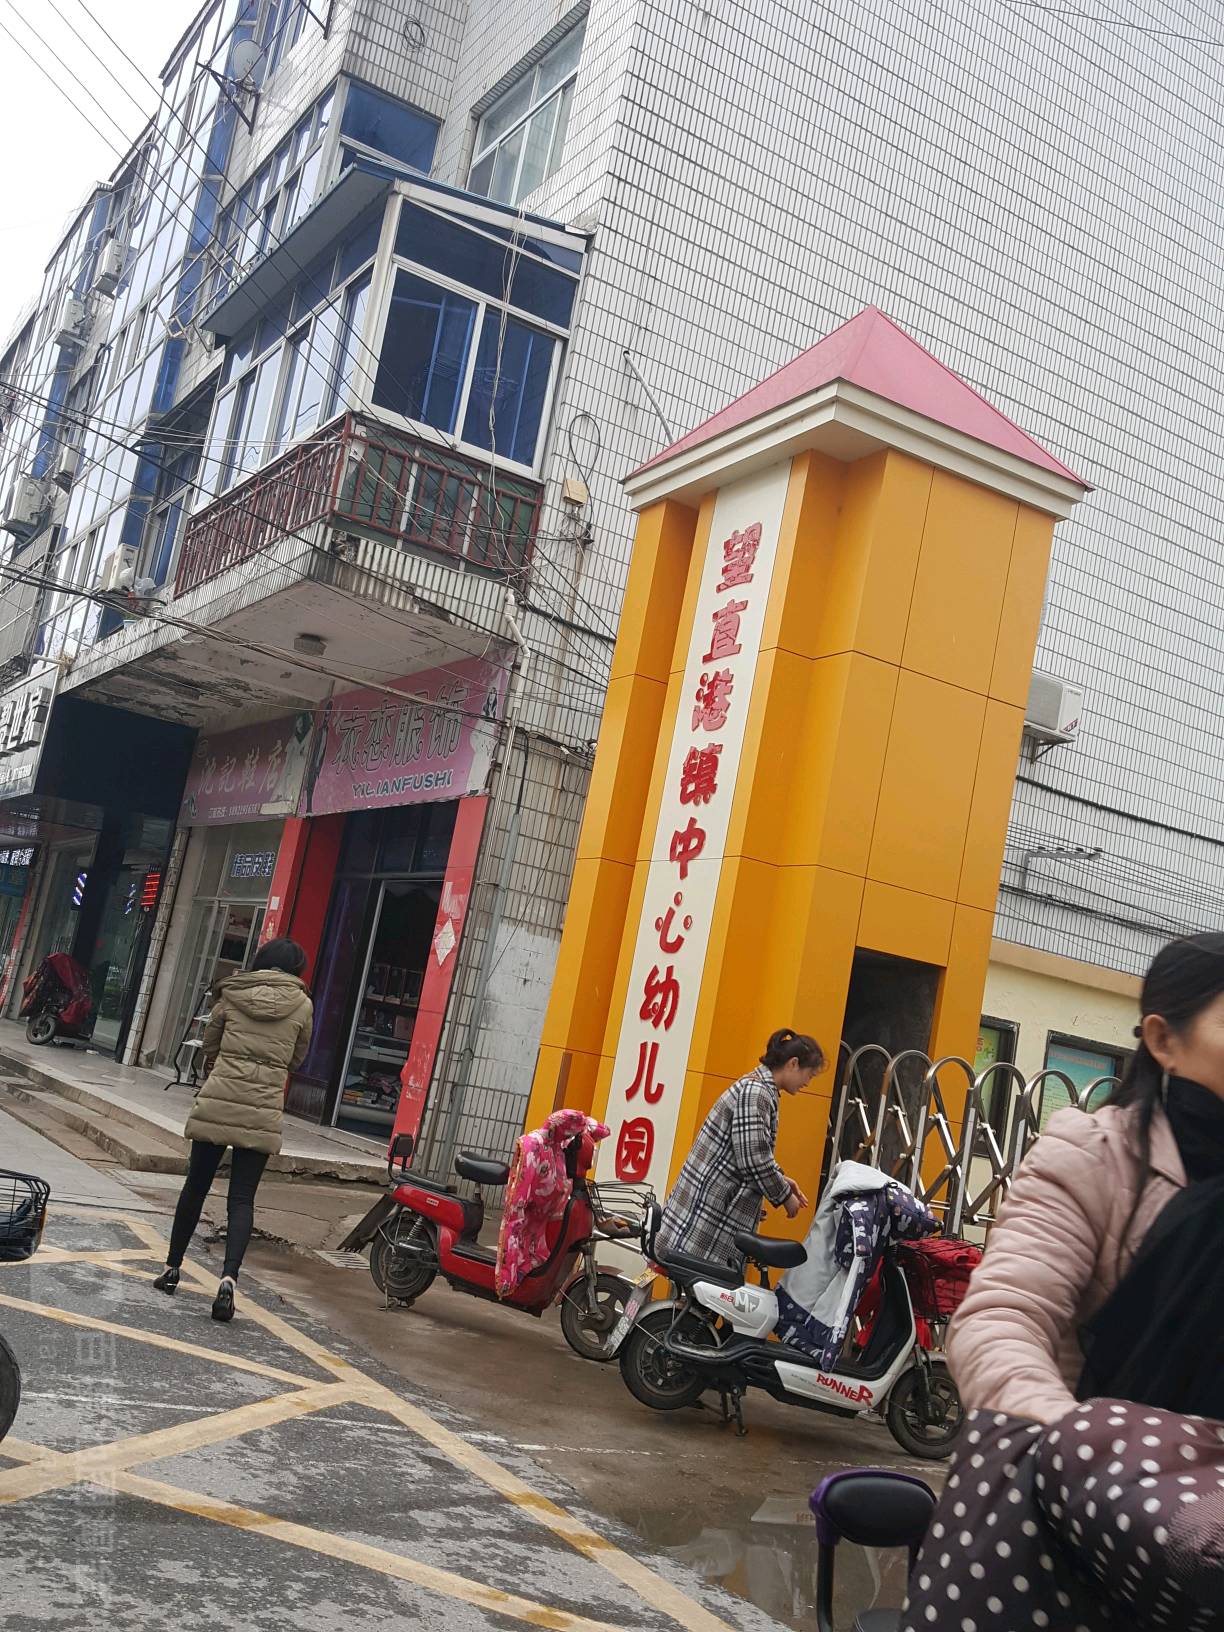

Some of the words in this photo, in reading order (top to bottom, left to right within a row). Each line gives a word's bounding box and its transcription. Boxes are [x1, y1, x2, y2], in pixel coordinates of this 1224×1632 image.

[351, 768, 454, 800] YILIANFUSHI
[614, 521, 763, 1183] 望直港镇中心幼儿园
[815, 1372, 874, 1406] RUNNER
